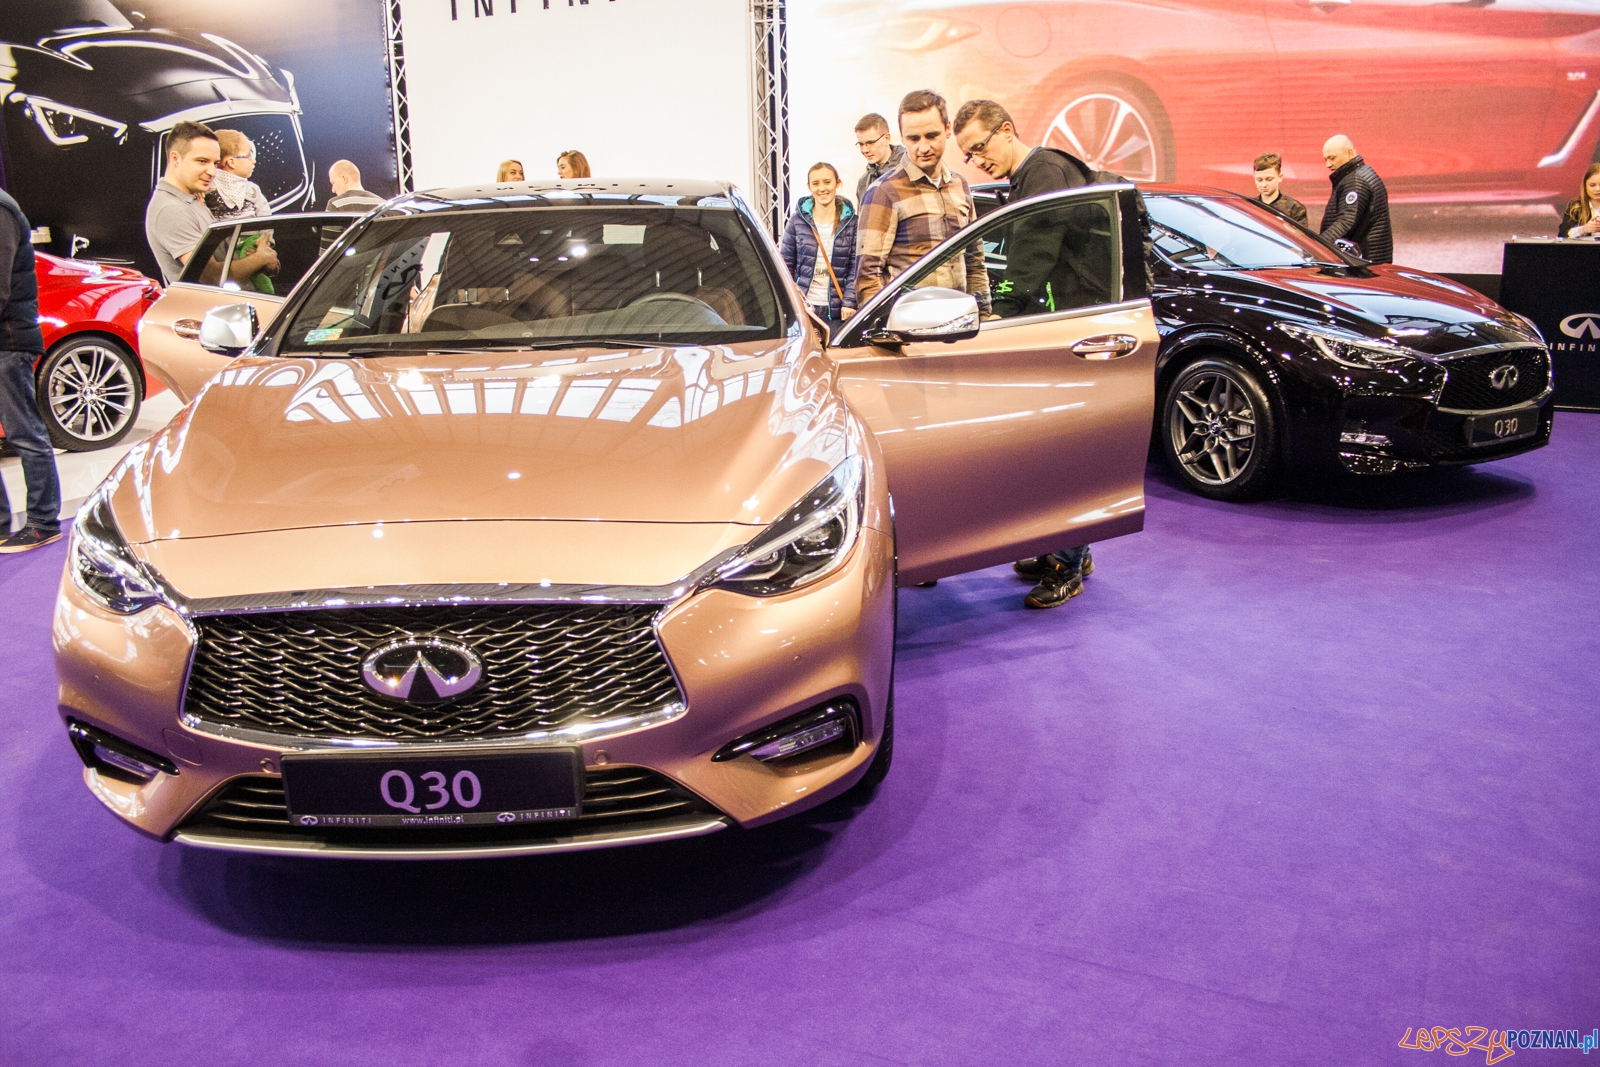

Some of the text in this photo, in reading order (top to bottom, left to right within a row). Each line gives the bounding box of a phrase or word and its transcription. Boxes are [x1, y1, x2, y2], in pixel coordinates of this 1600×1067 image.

[1494, 417, 1518, 438] Q30
[380, 769, 482, 813] Q30
[402, 815, 464, 824] www.infiniti.pl
[520, 809, 571, 819] INFINITI
